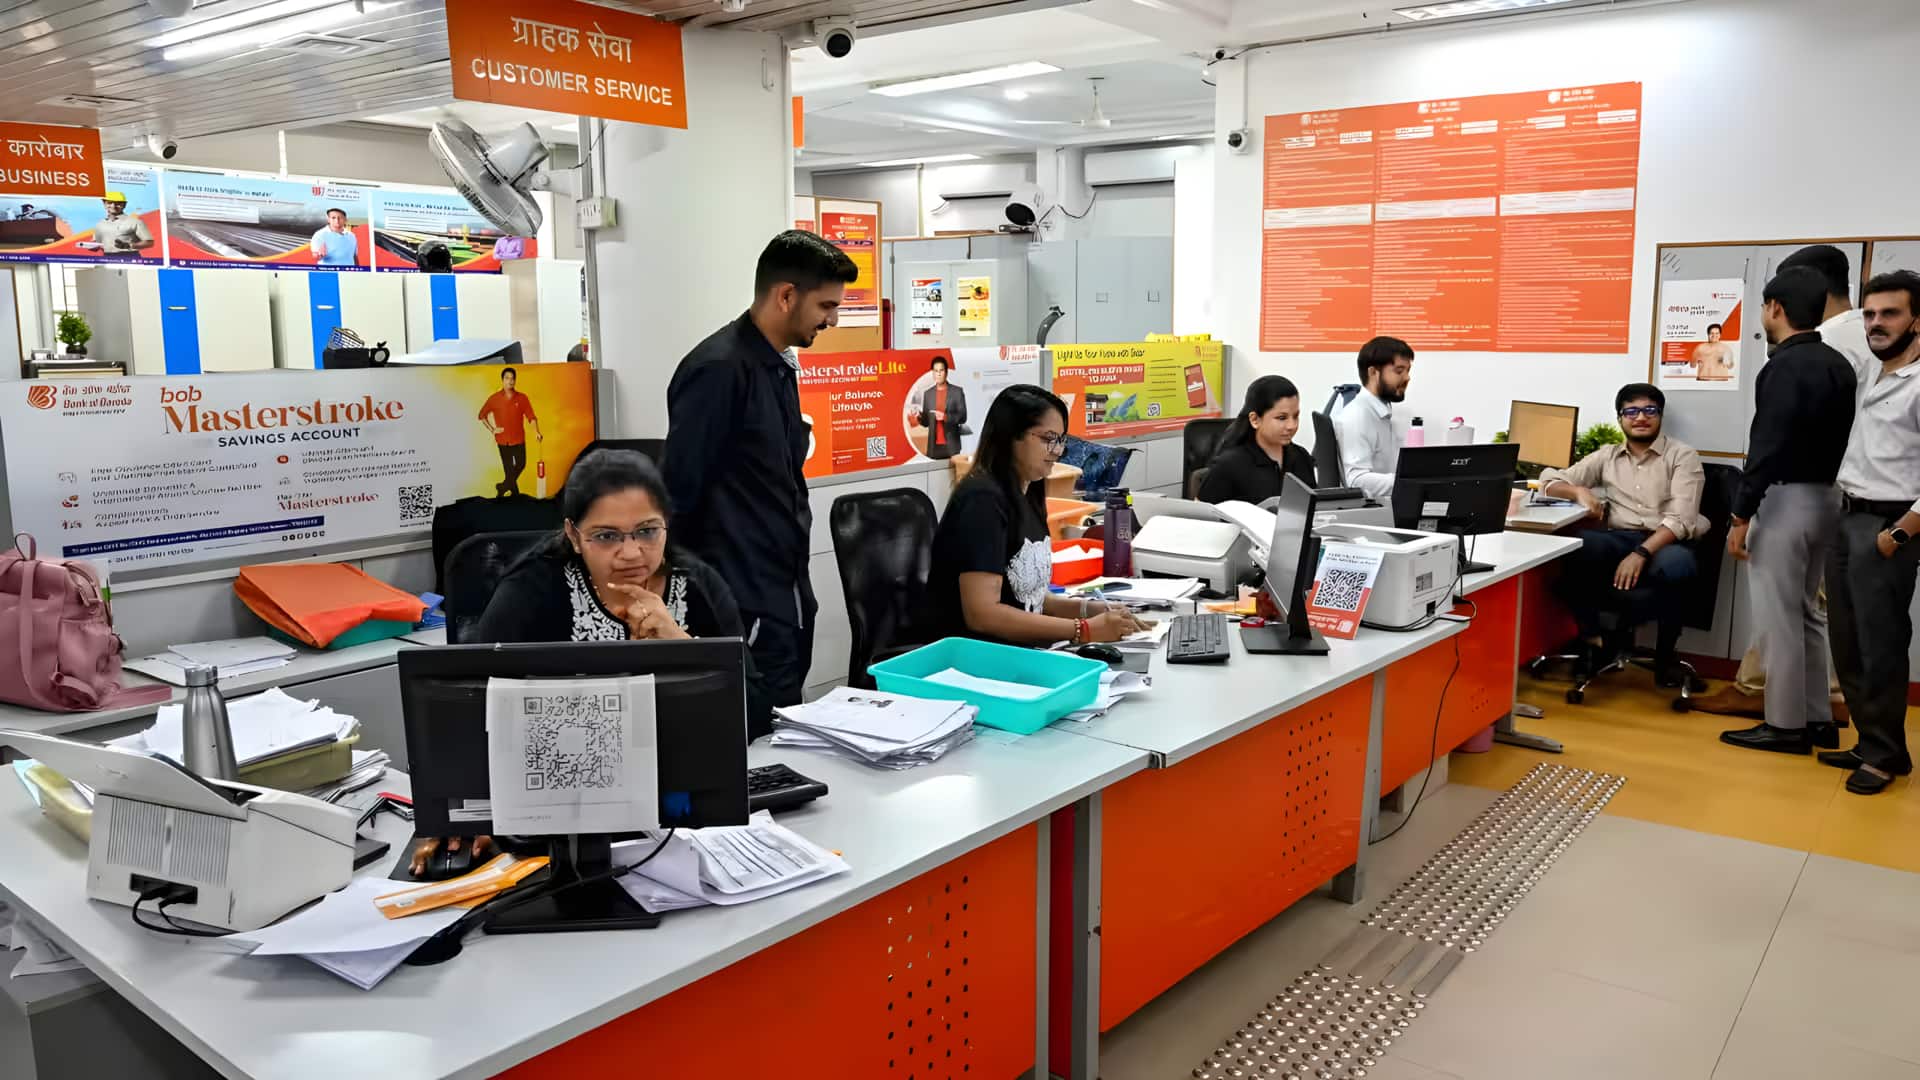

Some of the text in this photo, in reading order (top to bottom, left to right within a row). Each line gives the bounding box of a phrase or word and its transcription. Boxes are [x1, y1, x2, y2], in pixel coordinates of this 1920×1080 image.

[510, 16, 632, 63] ग्राहक सेवा
[472, 58, 673, 106] CUSTOMER SERVICE
[7, 135, 85, 160] कारोबार
[0, 168, 90, 187] BUSINESS
[161, 386, 202, 403] bob
[161, 395, 404, 434] Masterstroke
[218, 428, 361, 448] SAVINGS ACCOUNT
